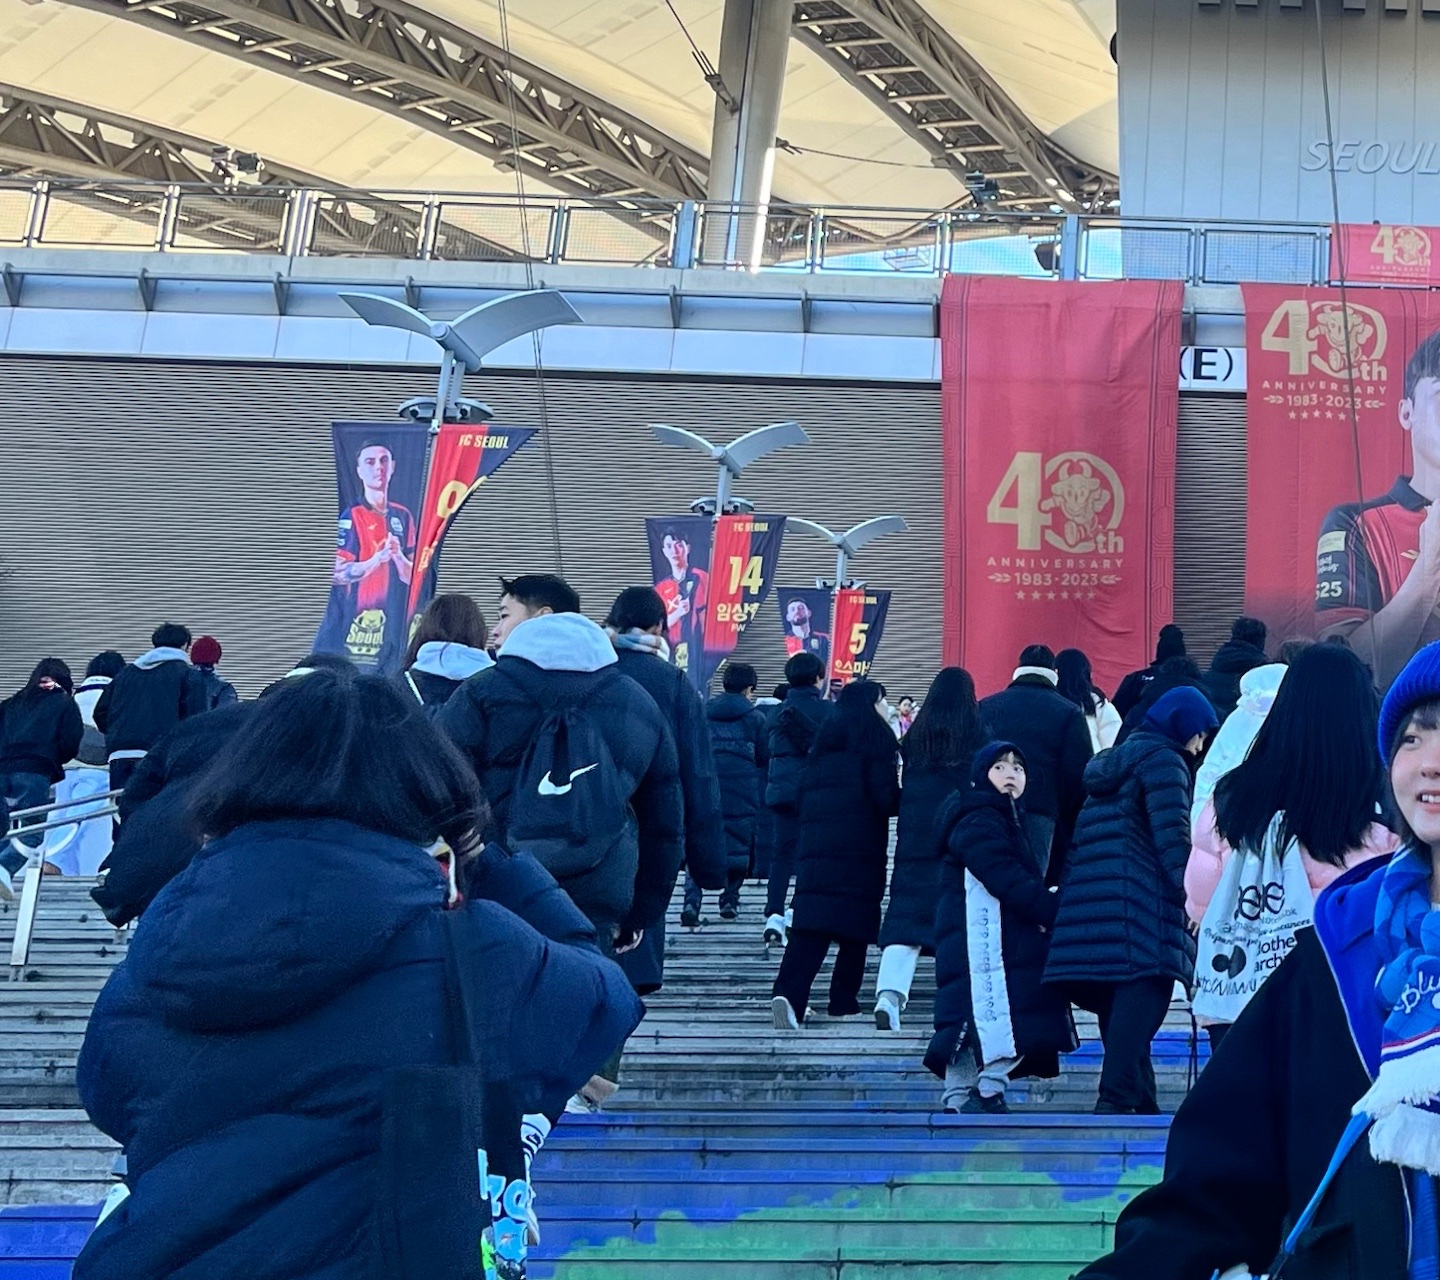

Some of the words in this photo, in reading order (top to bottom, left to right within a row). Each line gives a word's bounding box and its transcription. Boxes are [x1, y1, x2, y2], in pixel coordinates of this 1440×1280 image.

[1262, 380, 1387, 395] ANNIVERSARY
[458, 434, 473, 447] FC
[474, 435, 509, 449] SEOUL
[733, 522, 743, 532] FC
[744, 522, 769, 532] SEOUL
[987, 556, 1123, 569] ANNIVERSARY
[728, 556, 763, 595] 14
[858, 597, 878, 605] SEOUL
[731, 623, 747, 632] FW
[850, 623, 869, 655] 5
